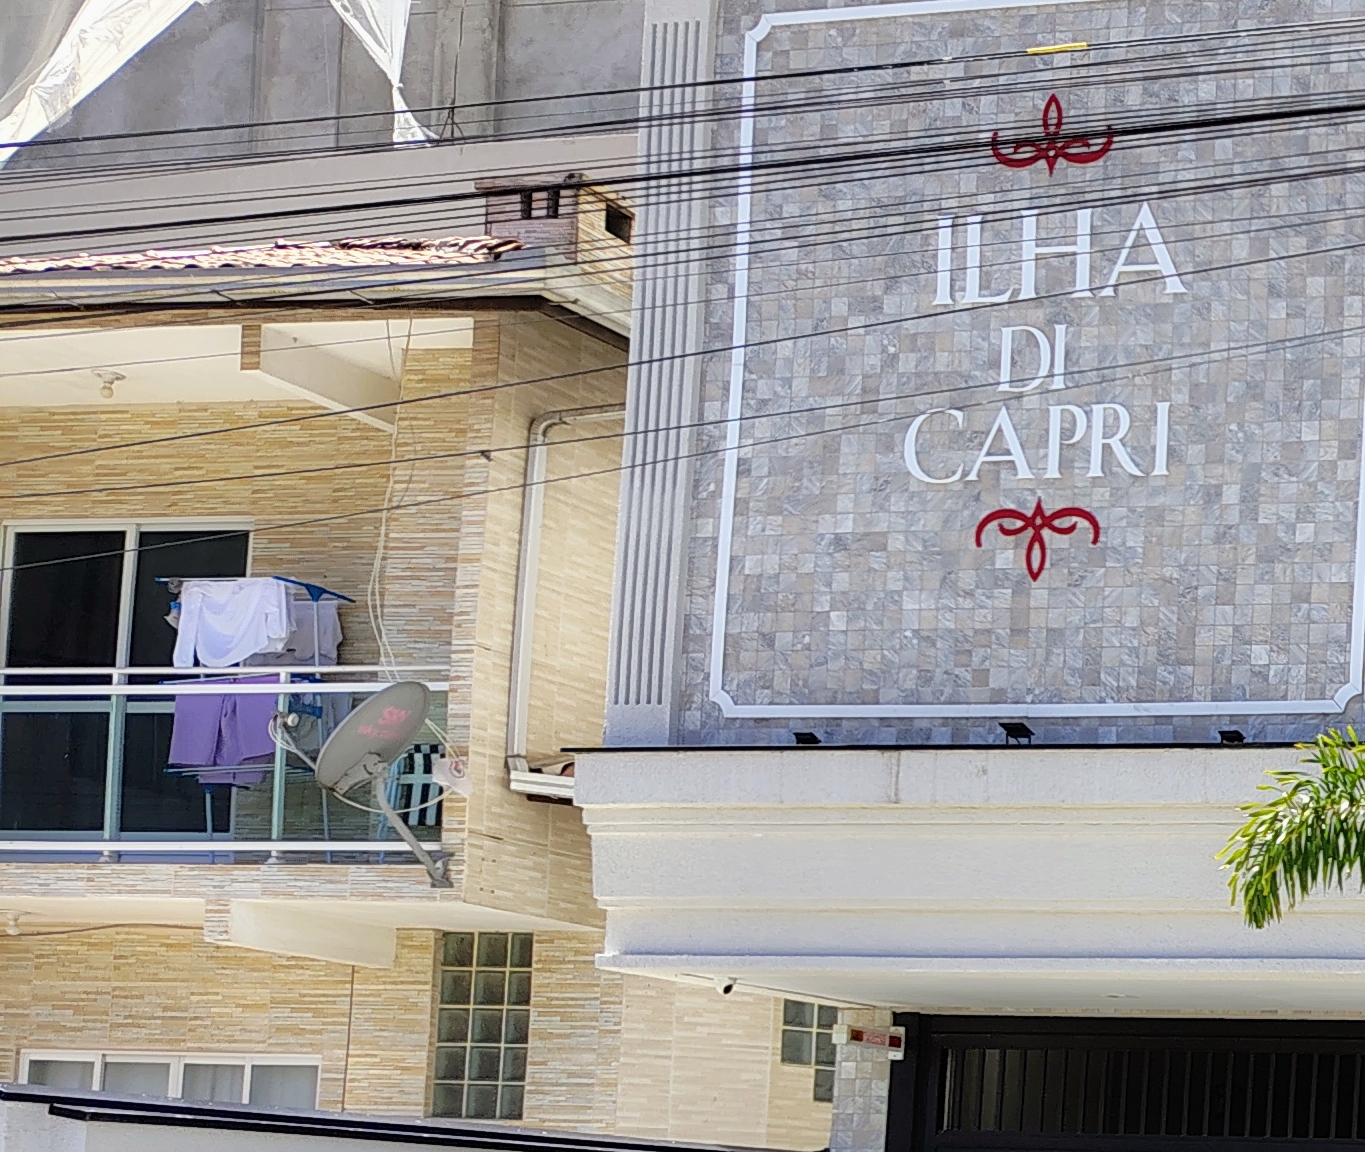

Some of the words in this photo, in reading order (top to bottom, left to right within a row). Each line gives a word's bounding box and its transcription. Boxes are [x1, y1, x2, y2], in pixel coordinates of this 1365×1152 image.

[931, 200, 1188, 306] ILHA
[997, 323, 1068, 393] DI
[903, 401, 1172, 484] CAPRI
